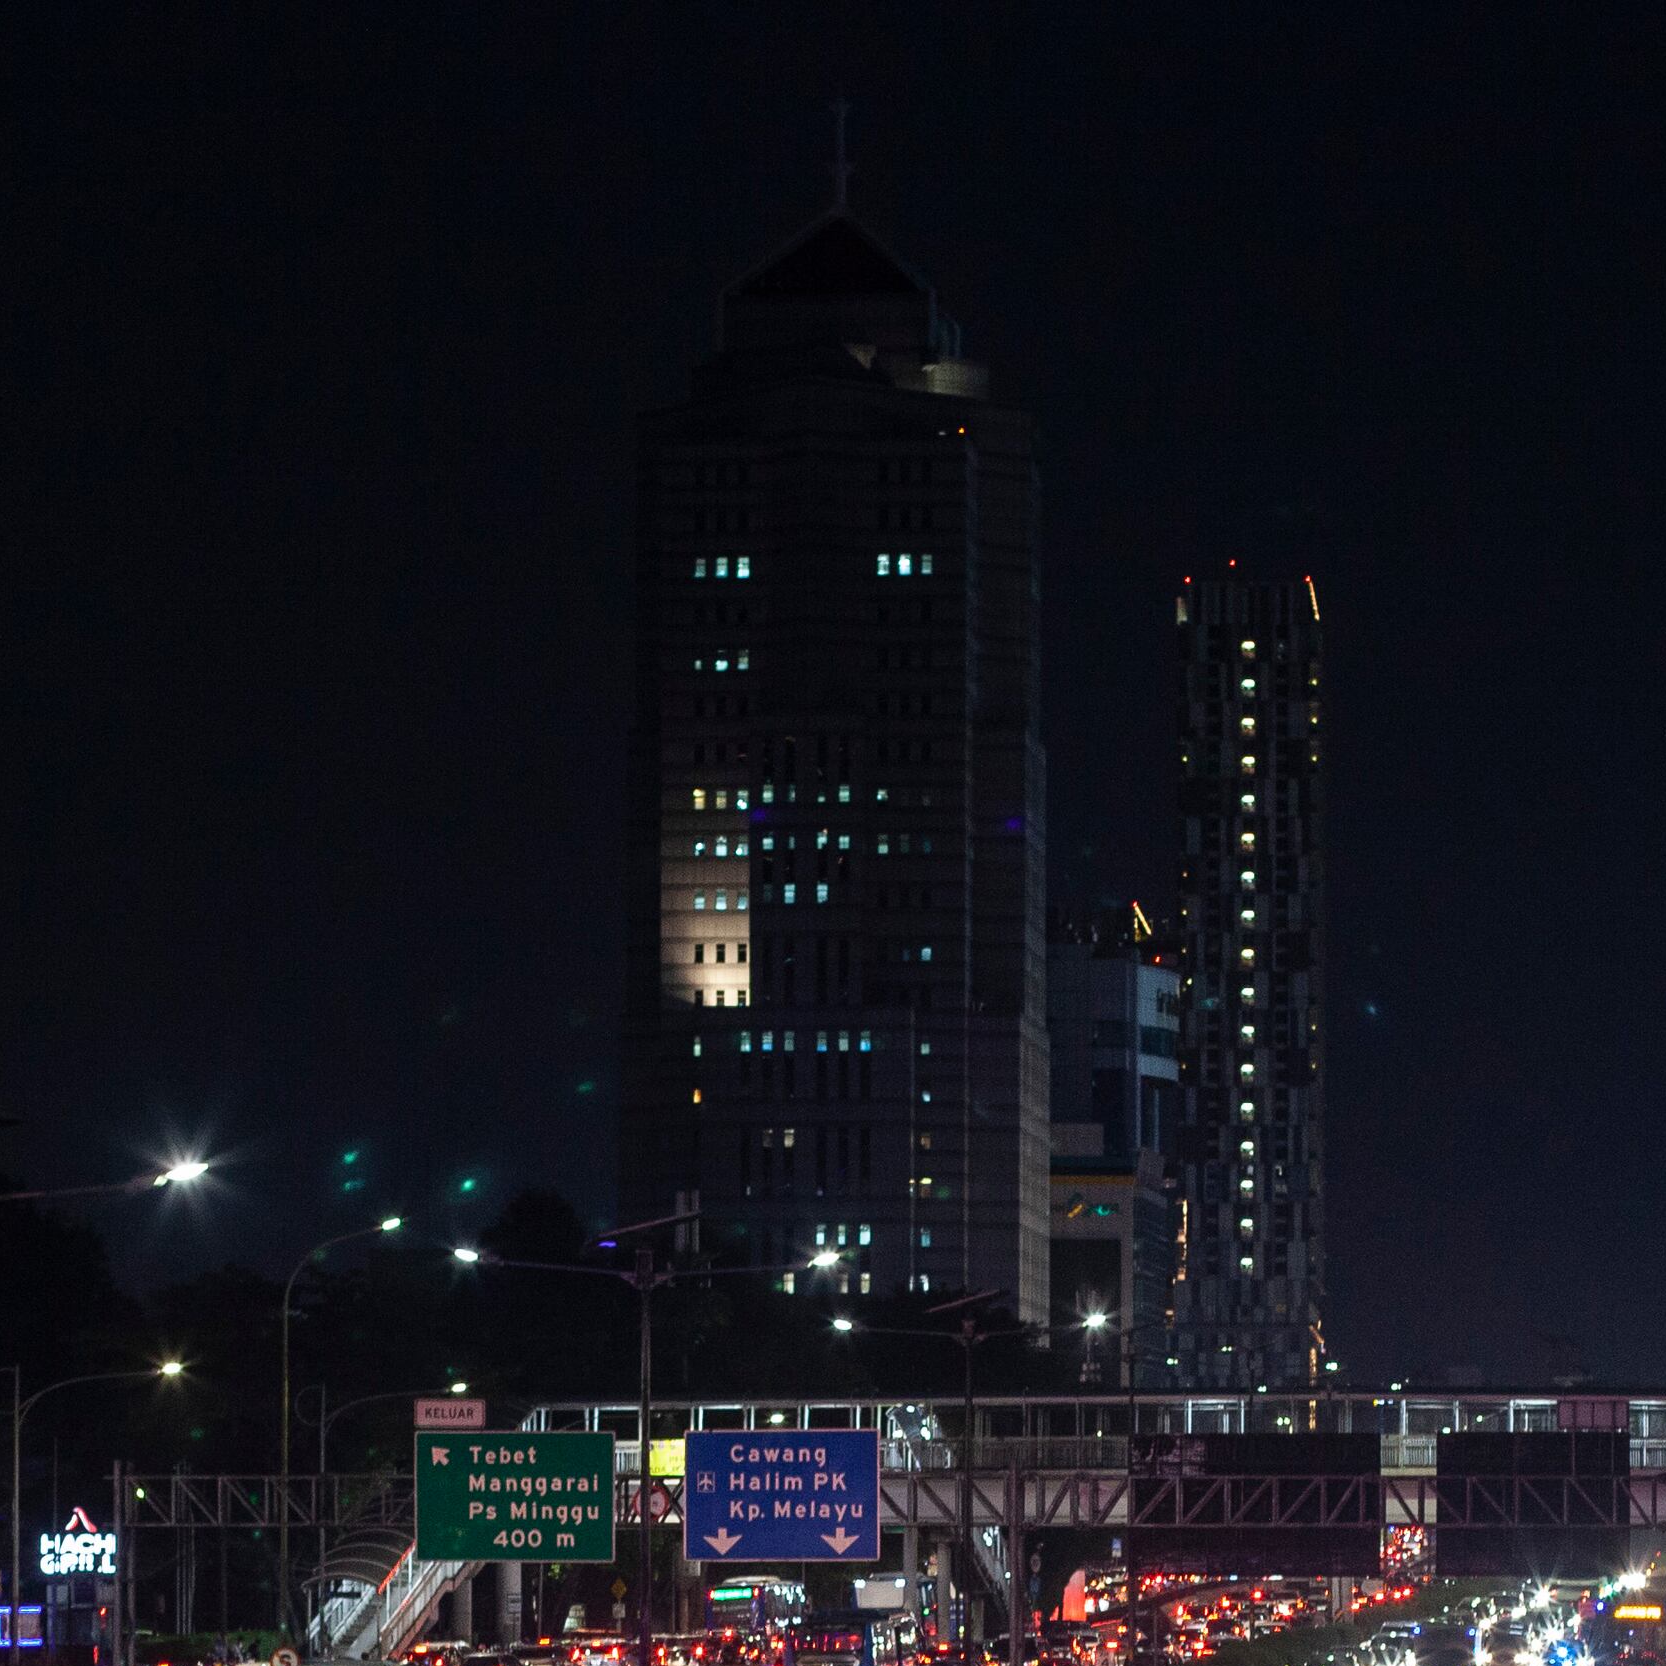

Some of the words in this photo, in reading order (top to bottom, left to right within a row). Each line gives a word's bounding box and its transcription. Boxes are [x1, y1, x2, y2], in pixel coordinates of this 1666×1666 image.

[425, 1407, 474, 1418] KELUAR
[469, 1446, 537, 1464] Tebet
[730, 1444, 827, 1467] Cawang
[468, 1473, 599, 1496] Manggarai
[729, 1473, 803, 1491] Halim
[813, 1473, 847, 1491] PK
[468, 1502, 497, 1520] Ps
[510, 1501, 600, 1525] Minggu
[729, 1500, 765, 1522] Kp.
[774, 1500, 863, 1522] Melayu
[493, 1529, 542, 1547] 400
[556, 1536, 575, 1547] m
